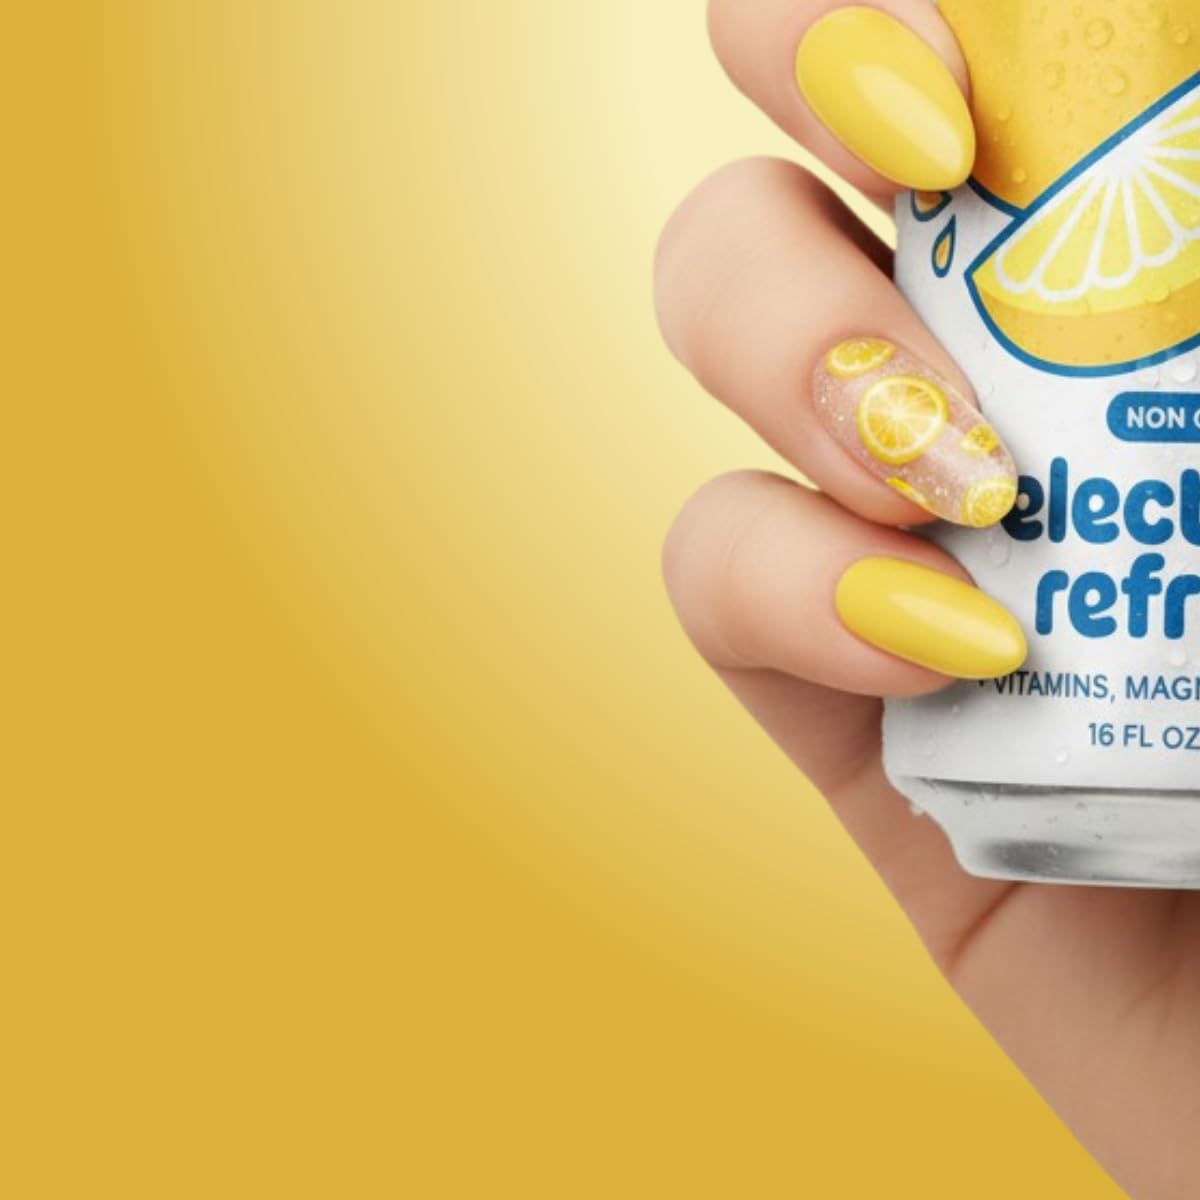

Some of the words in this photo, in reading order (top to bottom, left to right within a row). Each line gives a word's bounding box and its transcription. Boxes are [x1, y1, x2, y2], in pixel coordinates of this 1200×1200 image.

[1126, 405, 1185, 429] NON
[994, 671, 1115, 703] VITAMINS,
[1088, 722, 1114, 745] 16
[1123, 725, 1152, 747] FL
[1162, 726, 1200, 749] OZ
